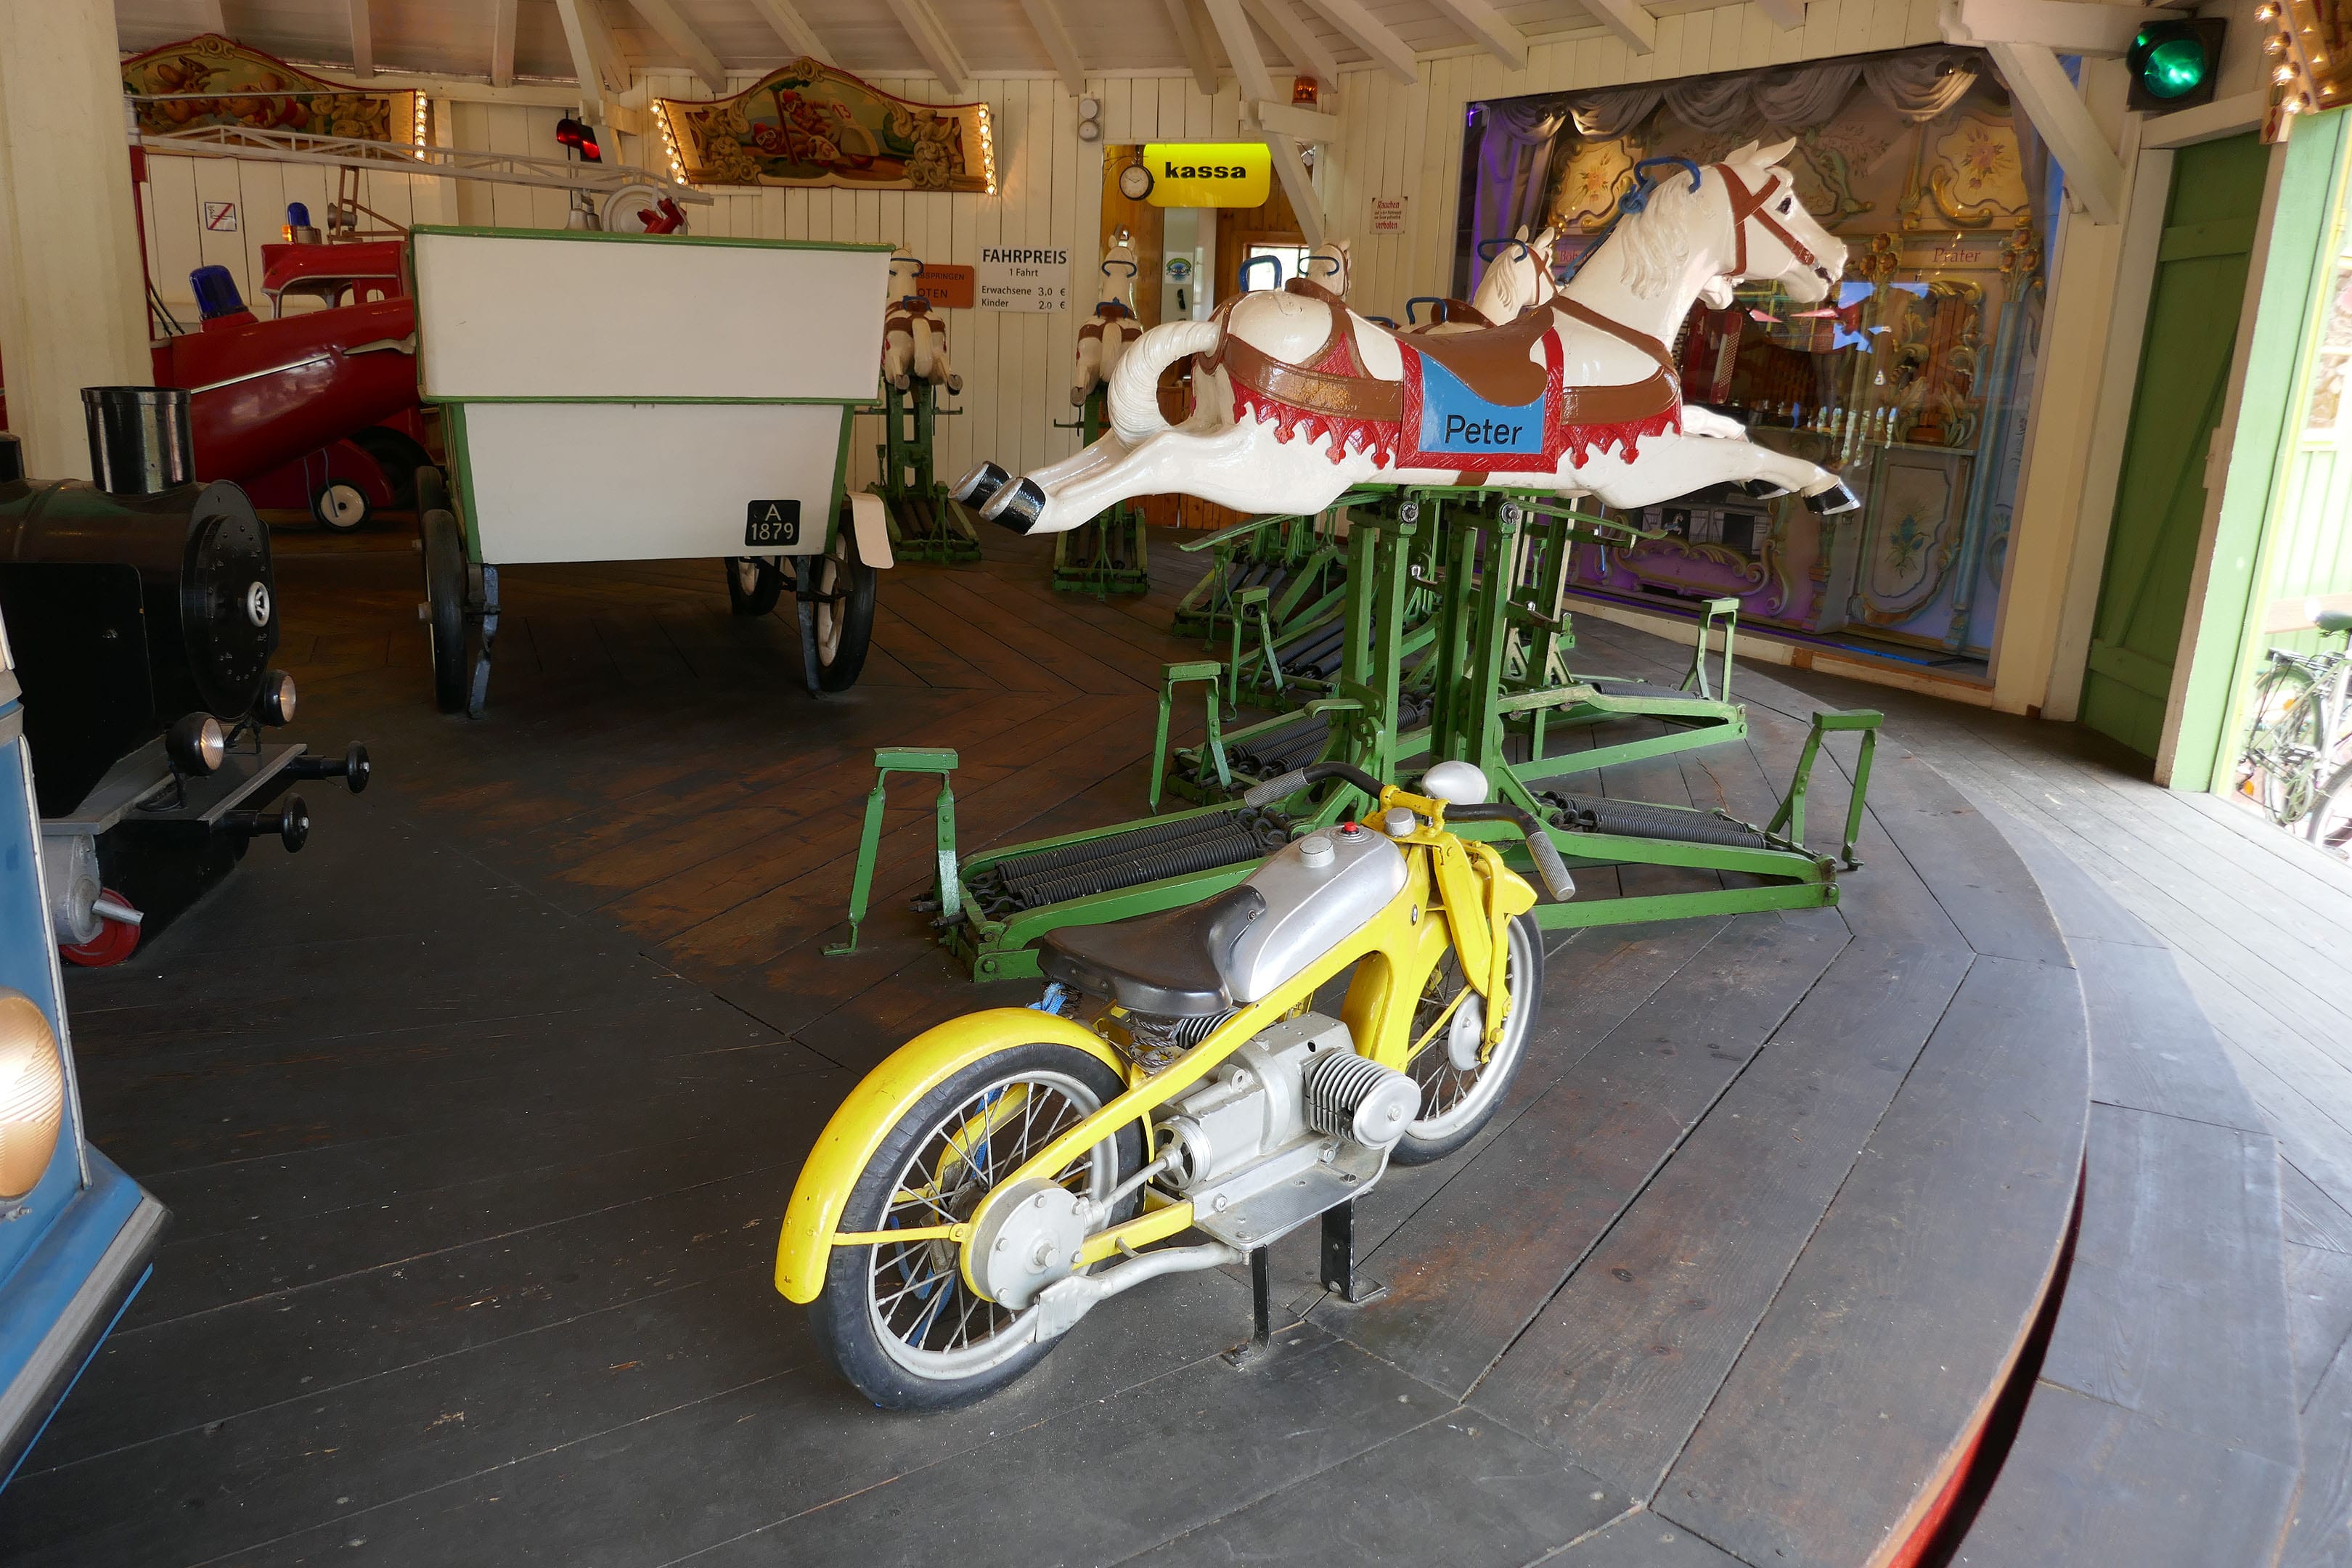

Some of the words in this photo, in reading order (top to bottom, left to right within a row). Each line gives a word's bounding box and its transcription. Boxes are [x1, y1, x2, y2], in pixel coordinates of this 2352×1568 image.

[832, 104, 852, 119] 13
[1165, 162, 1246, 179] kassa
[1377, 200, 1400, 210] Rauchen
[1375, 221, 1398, 229] verboten
[982, 248, 1067, 264] FAHRPREIS
[1933, 247, 1981, 263] Prater
[1010, 268, 1013, 277] 1
[1016, 268, 1039, 277] Fahrt
[917, 288, 948, 298] OTEN
[981, 285, 1032, 295] Erwachsene
[981, 298, 1010, 308] Kinder
[1445, 415, 1523, 445] Peter
[764, 503, 782, 521] A
[751, 523, 794, 541] 1879
